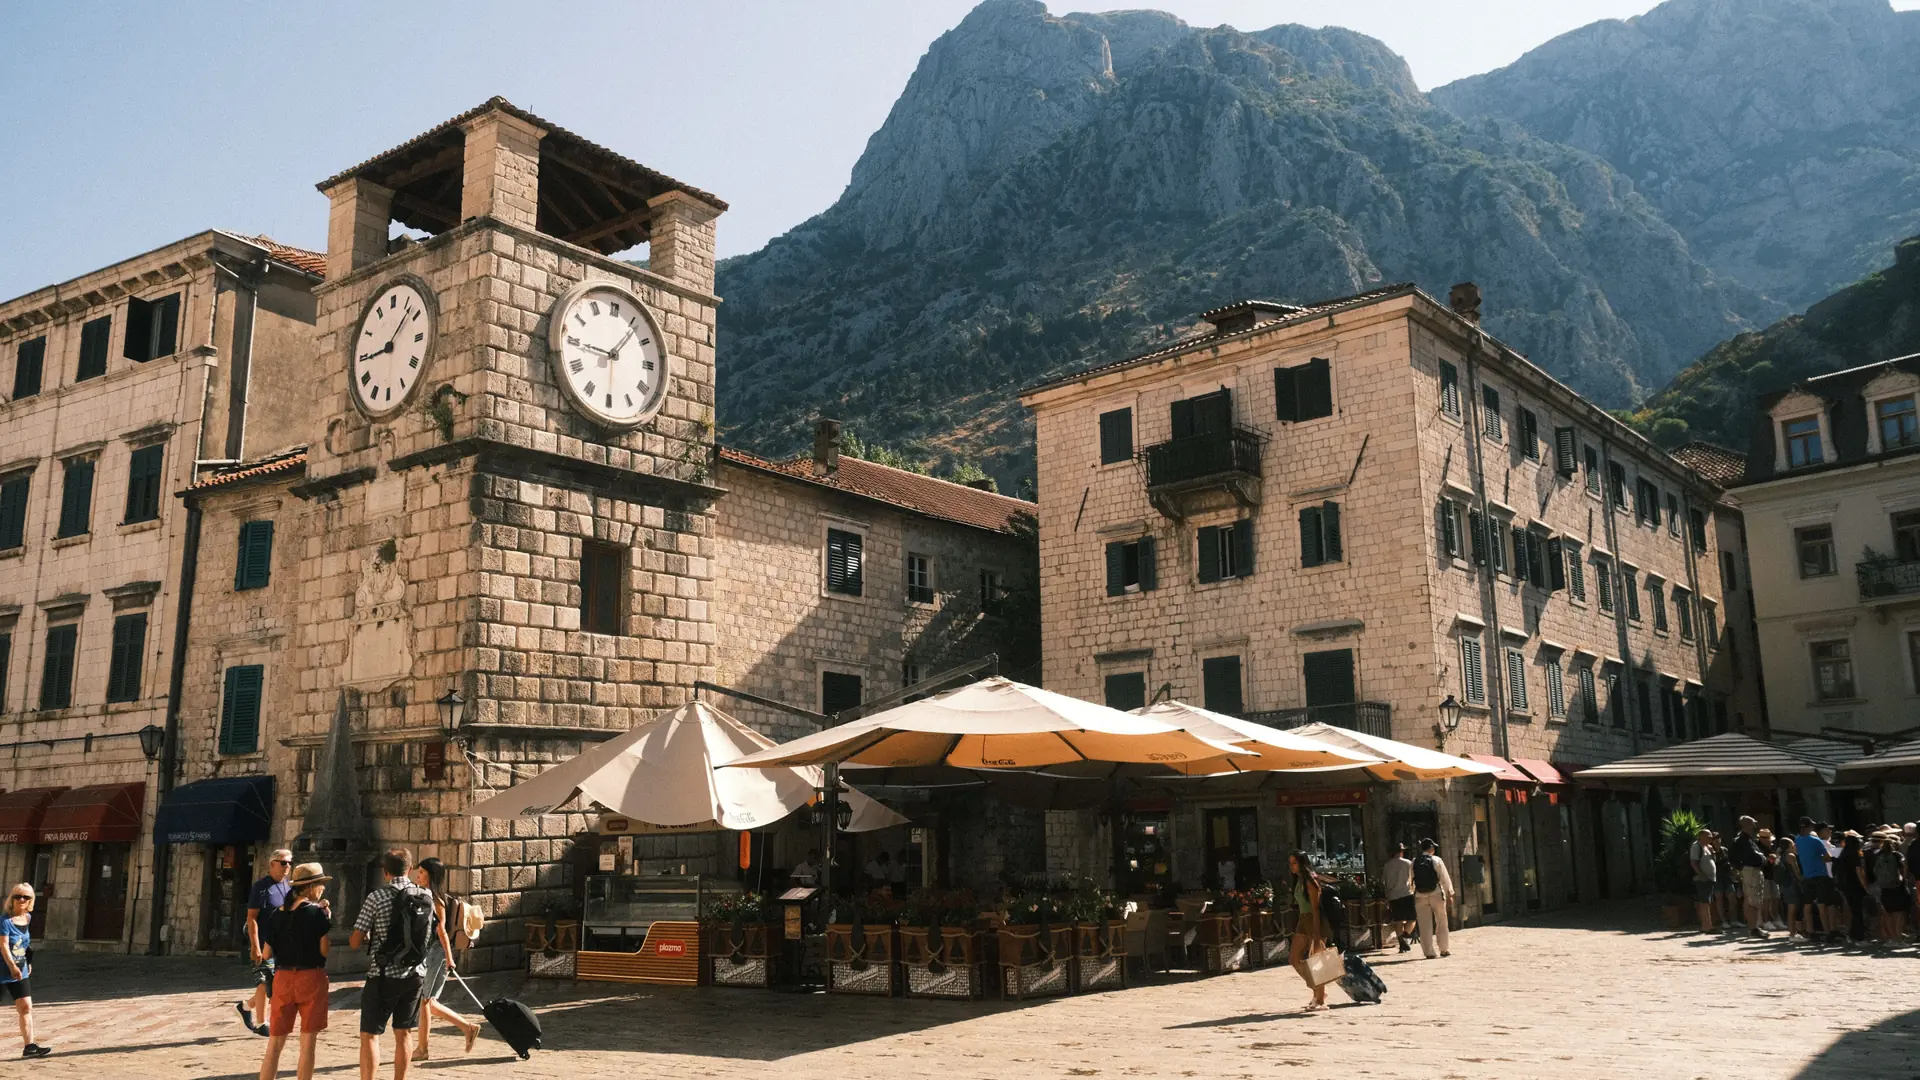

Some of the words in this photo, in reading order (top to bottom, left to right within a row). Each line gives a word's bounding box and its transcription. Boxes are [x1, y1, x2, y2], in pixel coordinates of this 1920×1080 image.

[44, 833, 59, 842] PRVA
[60, 832, 79, 841] BANKA
[80, 831, 89, 841] CG
